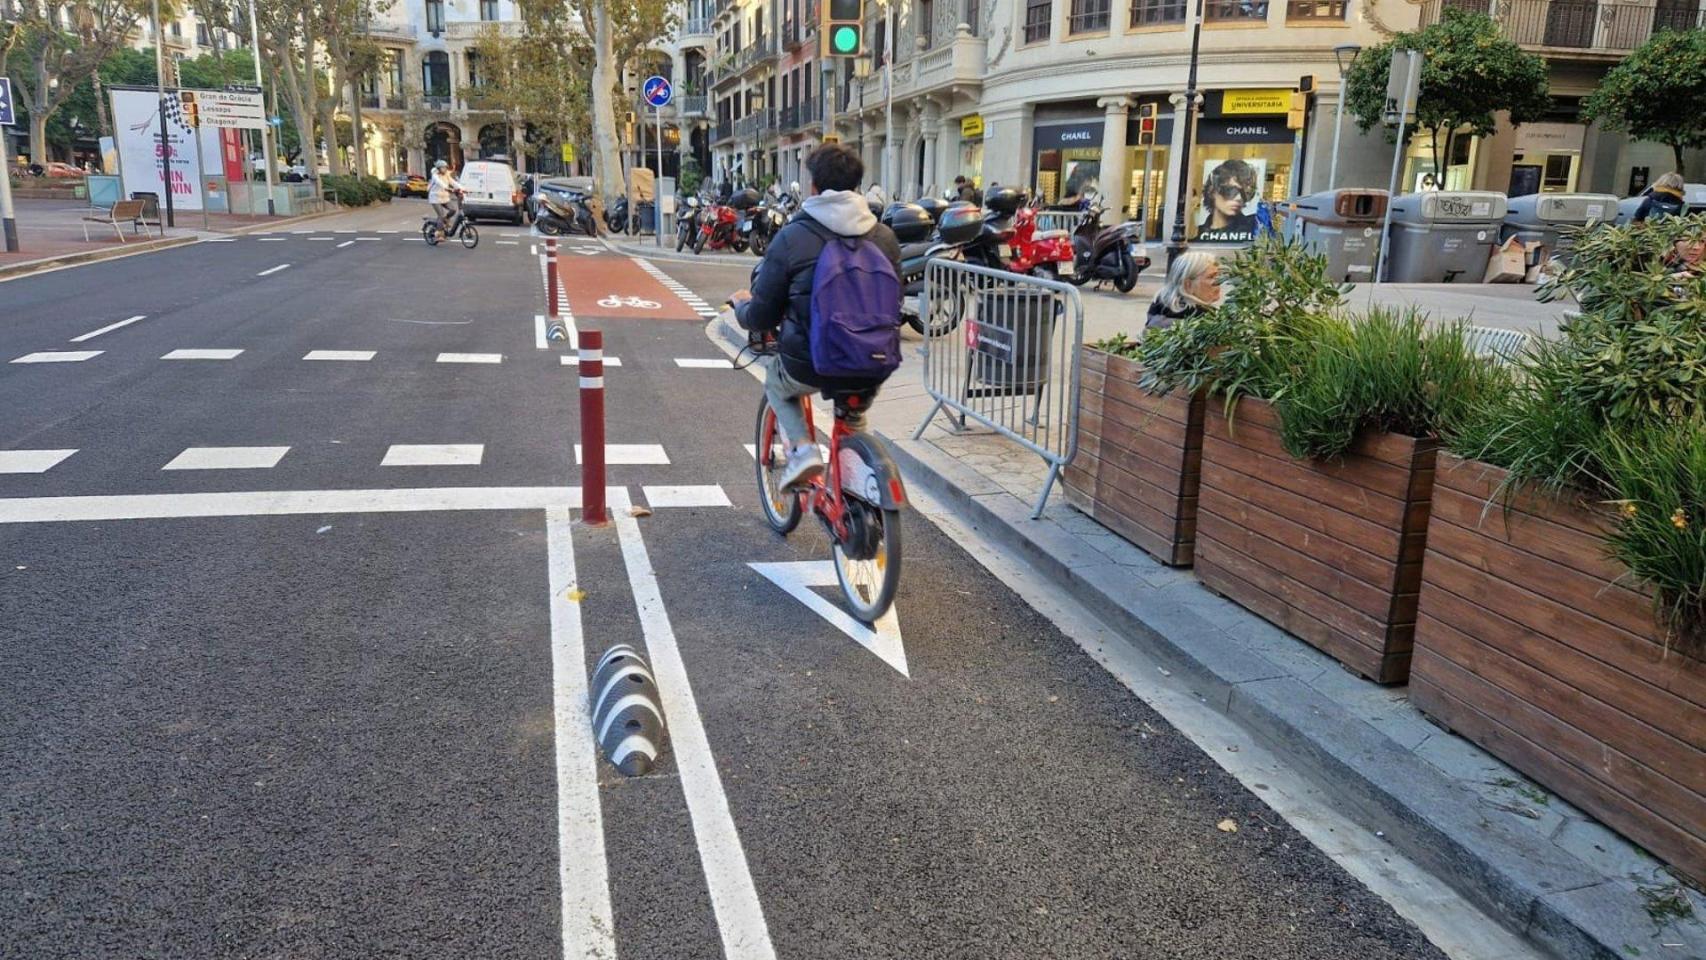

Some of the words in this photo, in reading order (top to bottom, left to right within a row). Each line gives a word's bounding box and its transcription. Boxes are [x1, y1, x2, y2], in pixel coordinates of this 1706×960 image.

[200, 92, 217, 100] Gran
[202, 105, 231, 113] Lesseps
[206, 117, 238, 126] Diagonal
[1226, 127, 1268, 135] CHANEL
[1061, 131, 1091, 141] CHANEL
[1200, 231, 1252, 241] CHANEL
